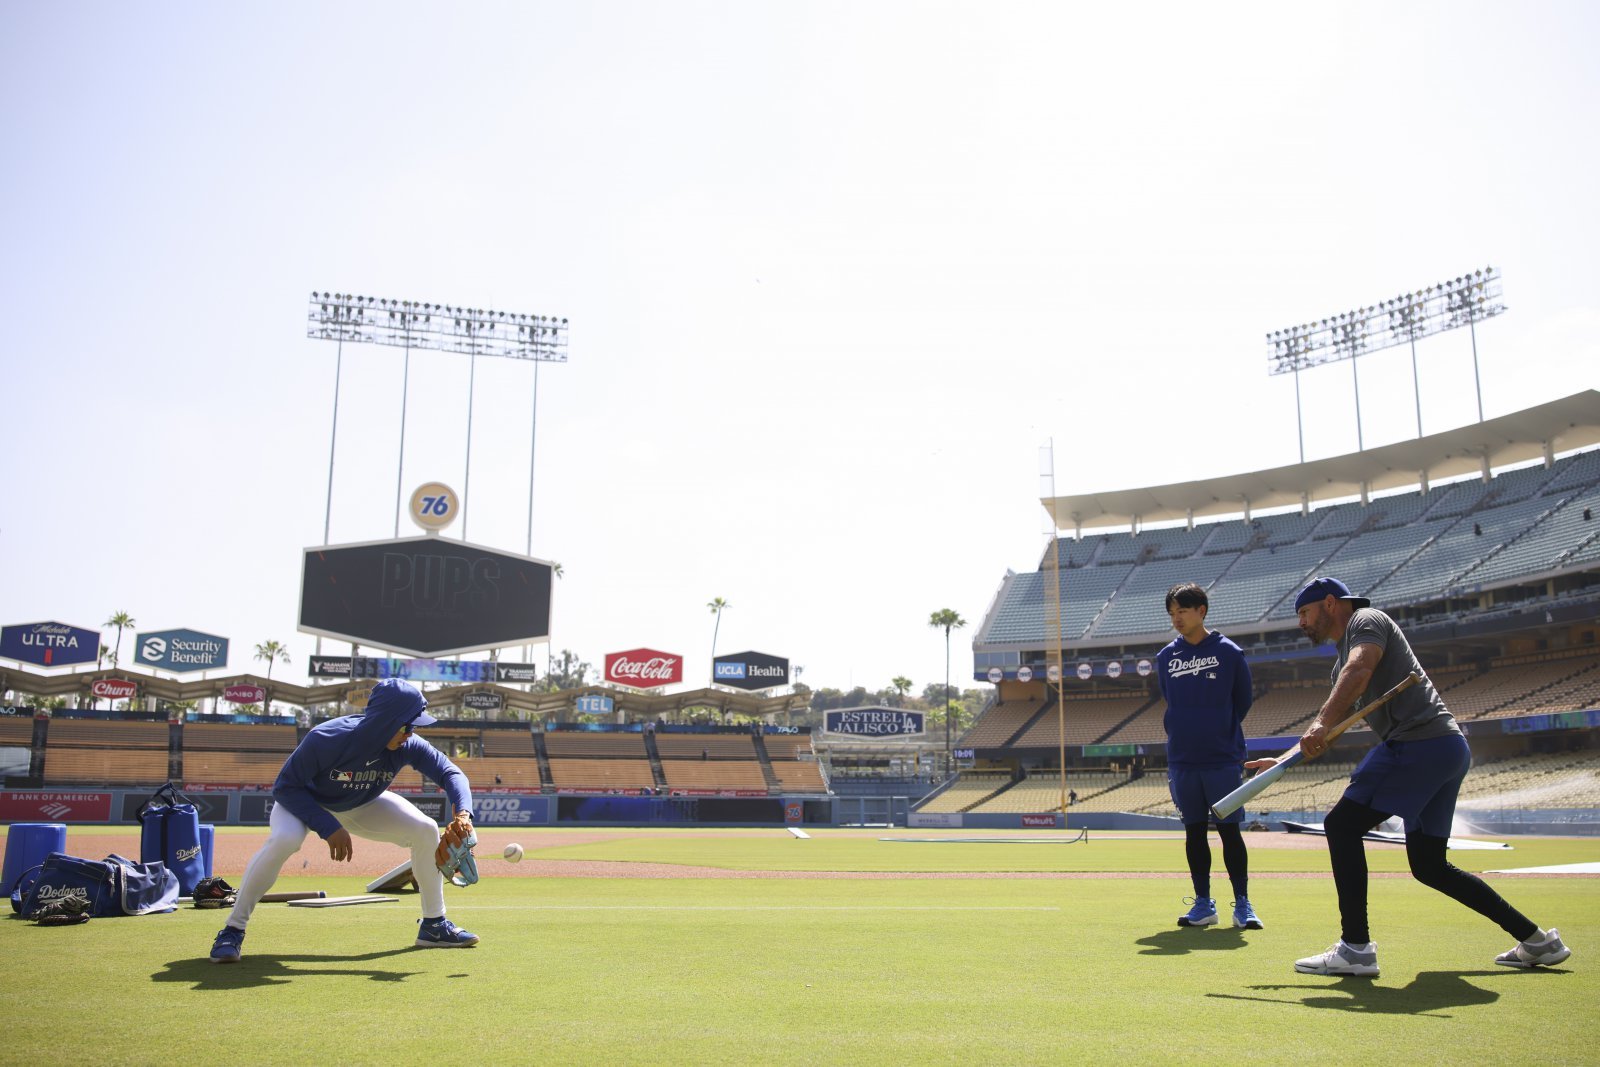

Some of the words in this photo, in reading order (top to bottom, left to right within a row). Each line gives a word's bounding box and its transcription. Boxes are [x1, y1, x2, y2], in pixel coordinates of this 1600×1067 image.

[420, 495, 449, 516] 76
[381, 552, 501, 610] PUPS
[22, 633, 78, 648] ULTRA
[171, 638, 221, 653] Security
[171, 650, 213, 664] Benefit
[610, 656, 677, 680] Coca-Cola
[717, 665, 743, 675] UCLA
[748, 665, 784, 677] Health
[1168, 655, 1219, 678] Dodgers
[94, 682, 135, 696] Churu
[581, 698, 608, 711] TEL
[834, 722, 899, 734] JALISCO
[472, 798, 521, 811] TOYO
[479, 810, 532, 823] TIRES
[787, 807, 800, 817] 76
[37, 884, 88, 902] Dodgers
